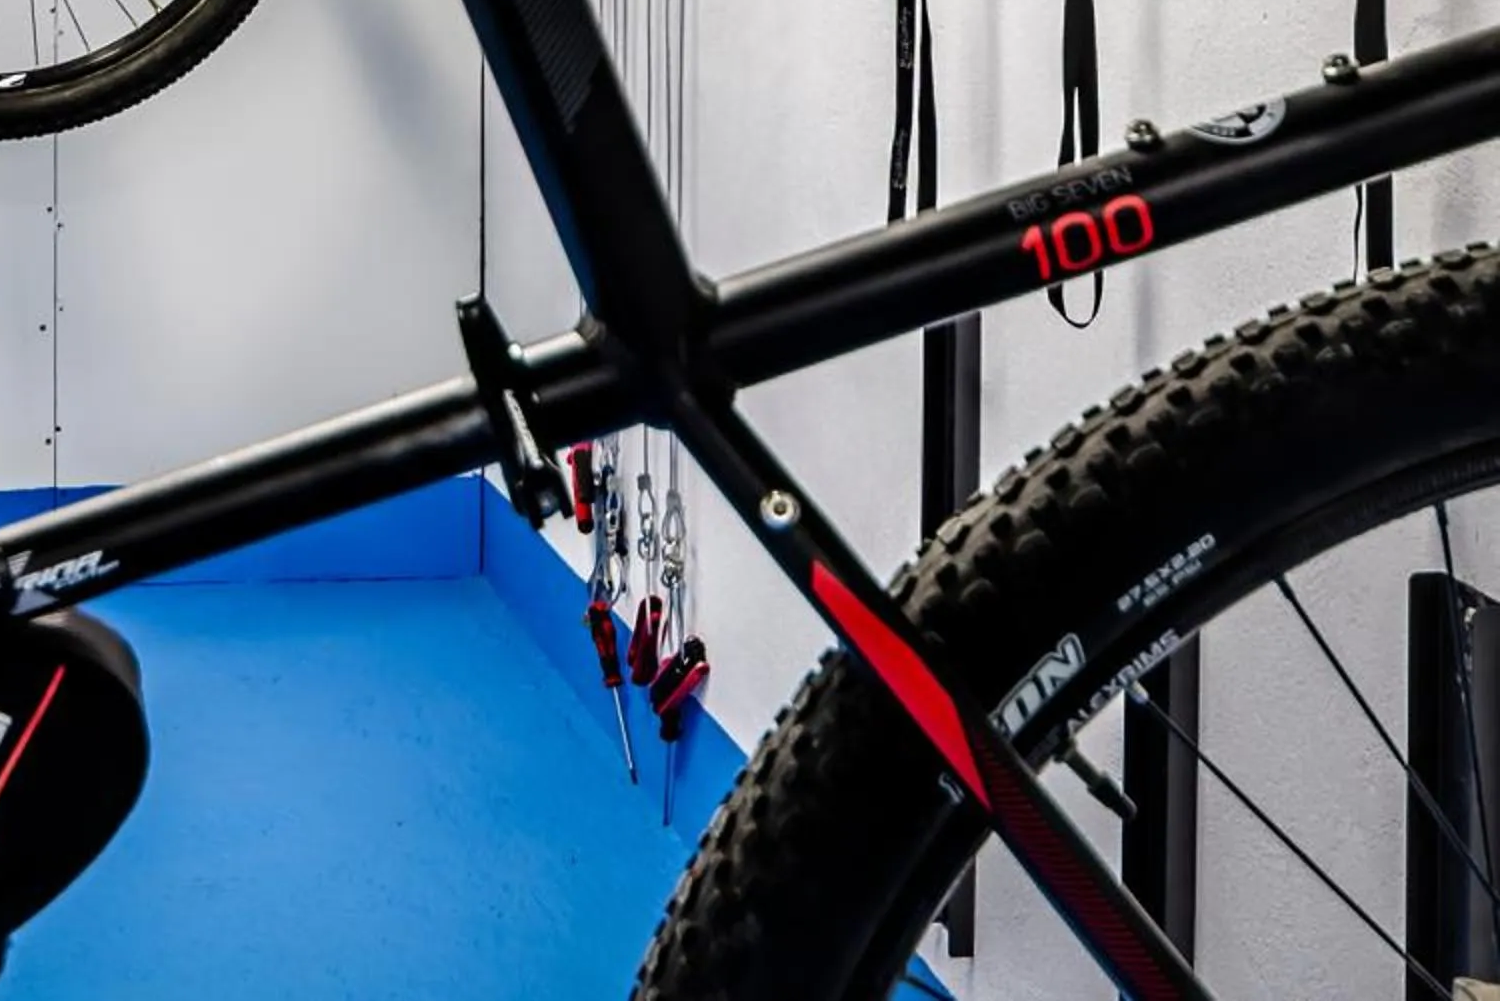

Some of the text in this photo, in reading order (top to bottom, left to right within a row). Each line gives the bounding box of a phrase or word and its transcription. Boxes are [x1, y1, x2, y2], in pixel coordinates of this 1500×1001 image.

[1008, 166, 1133, 222] BIG SEVEN
[1020, 194, 1154, 281] 100
[991, 634, 1086, 738] ON
